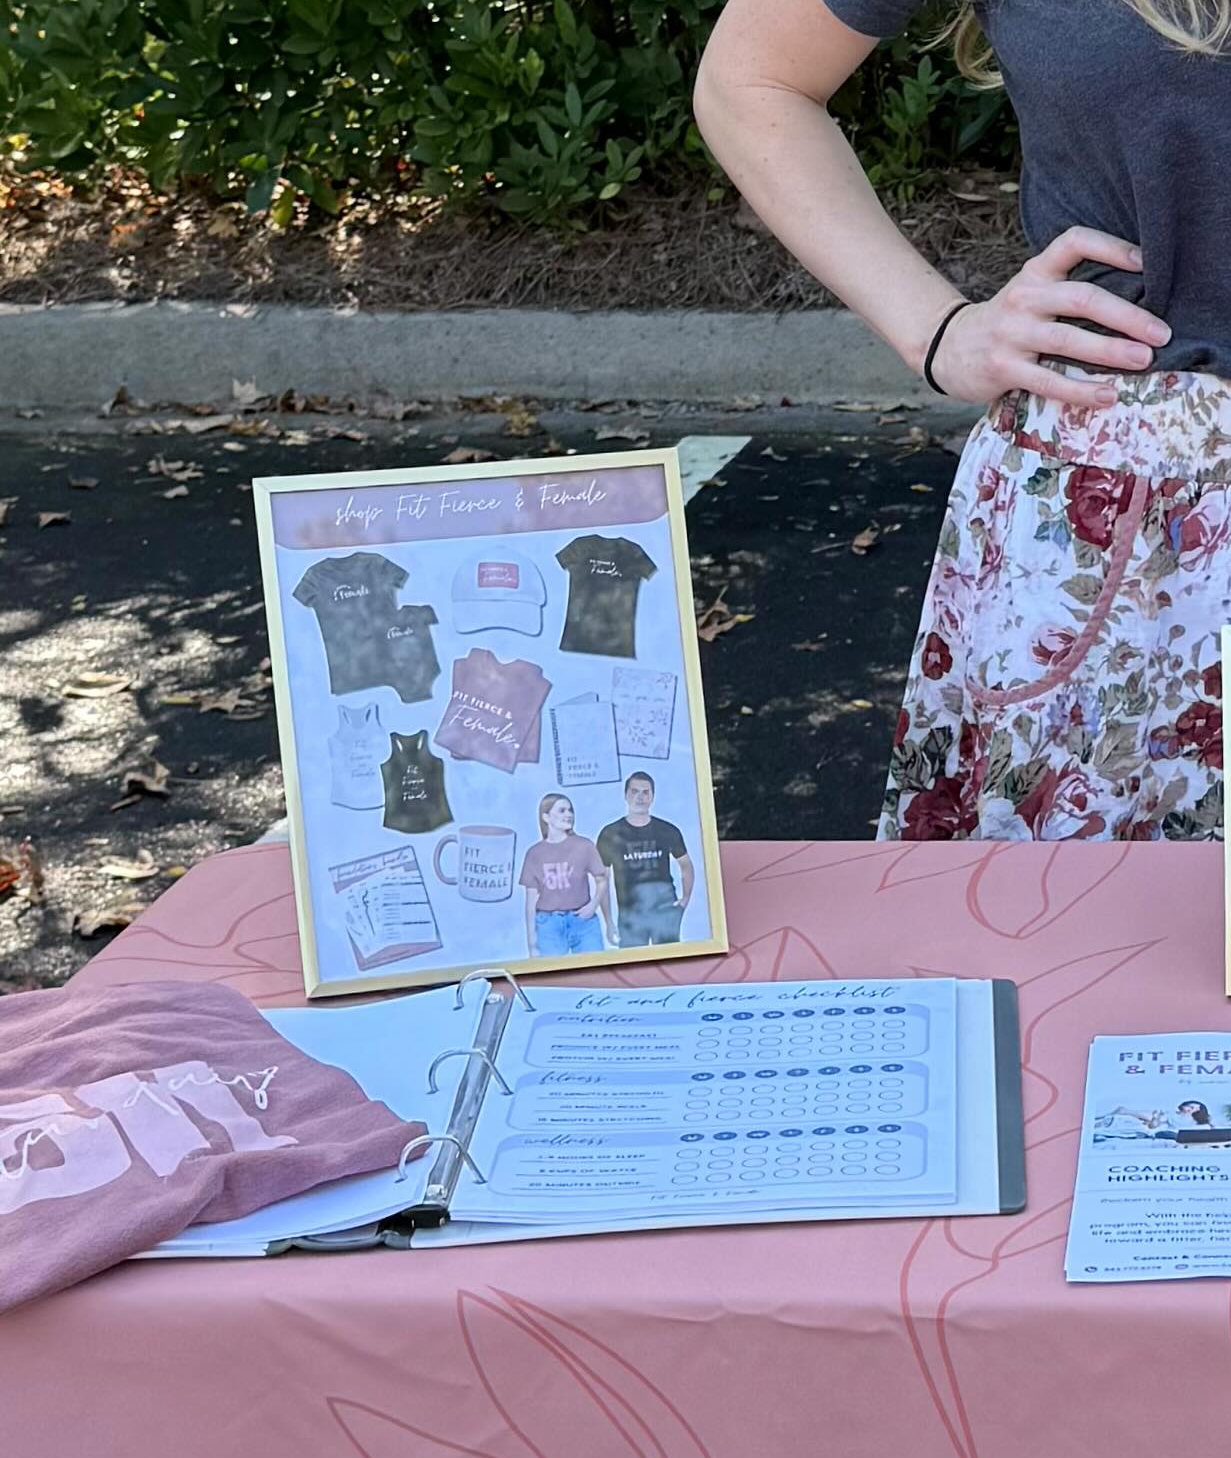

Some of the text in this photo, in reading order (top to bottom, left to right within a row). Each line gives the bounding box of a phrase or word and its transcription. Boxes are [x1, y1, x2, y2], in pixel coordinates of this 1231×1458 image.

[335, 479, 607, 530] shop Fit Fierce & Female
[464, 846, 480, 857] FIT
[463, 861, 503, 874] FIERCE
[463, 877, 509, 890] FEMALE
[575, 994, 622, 1010] fit
[627, 991, 676, 1008] and
[1119, 1052, 1164, 1062] FIT
[1125, 1065, 1145, 1074] &
[1108, 1165, 1221, 1174] COACHING
[1108, 1174, 1229, 1183] HIGHLIGHTS
